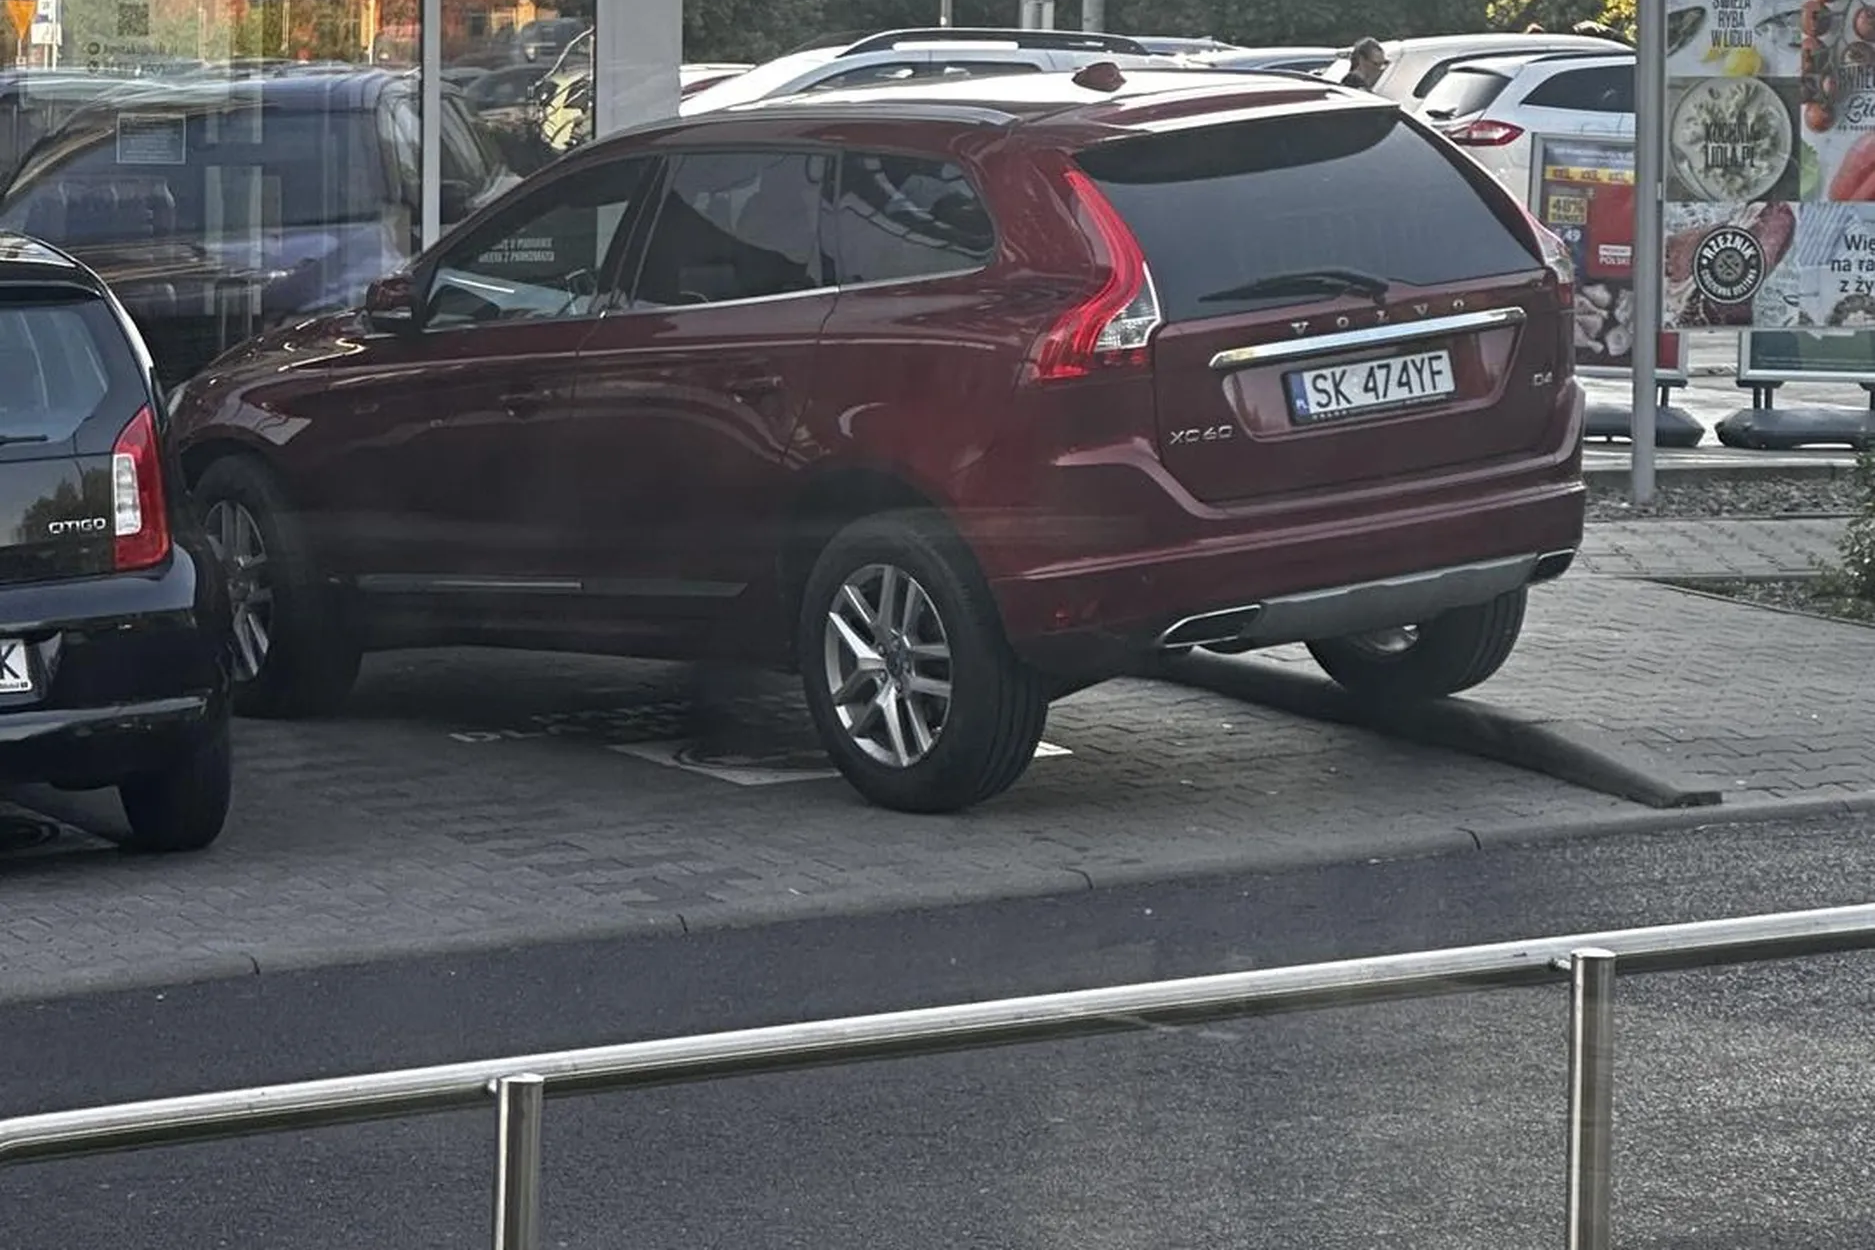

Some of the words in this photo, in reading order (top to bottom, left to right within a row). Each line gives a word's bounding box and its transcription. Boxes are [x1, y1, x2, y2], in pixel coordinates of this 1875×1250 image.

[1718, 11, 1746, 29] RYBA
[1831, 258, 1852, 272] na
[1839, 280, 1850, 293] z
[1291, 299, 1465, 335] VOLVO
[1312, 369, 1353, 408] SK
[1363, 355, 1443, 401] 474YF
[1533, 371, 1553, 386] D4
[1169, 424, 1233, 445] XC60
